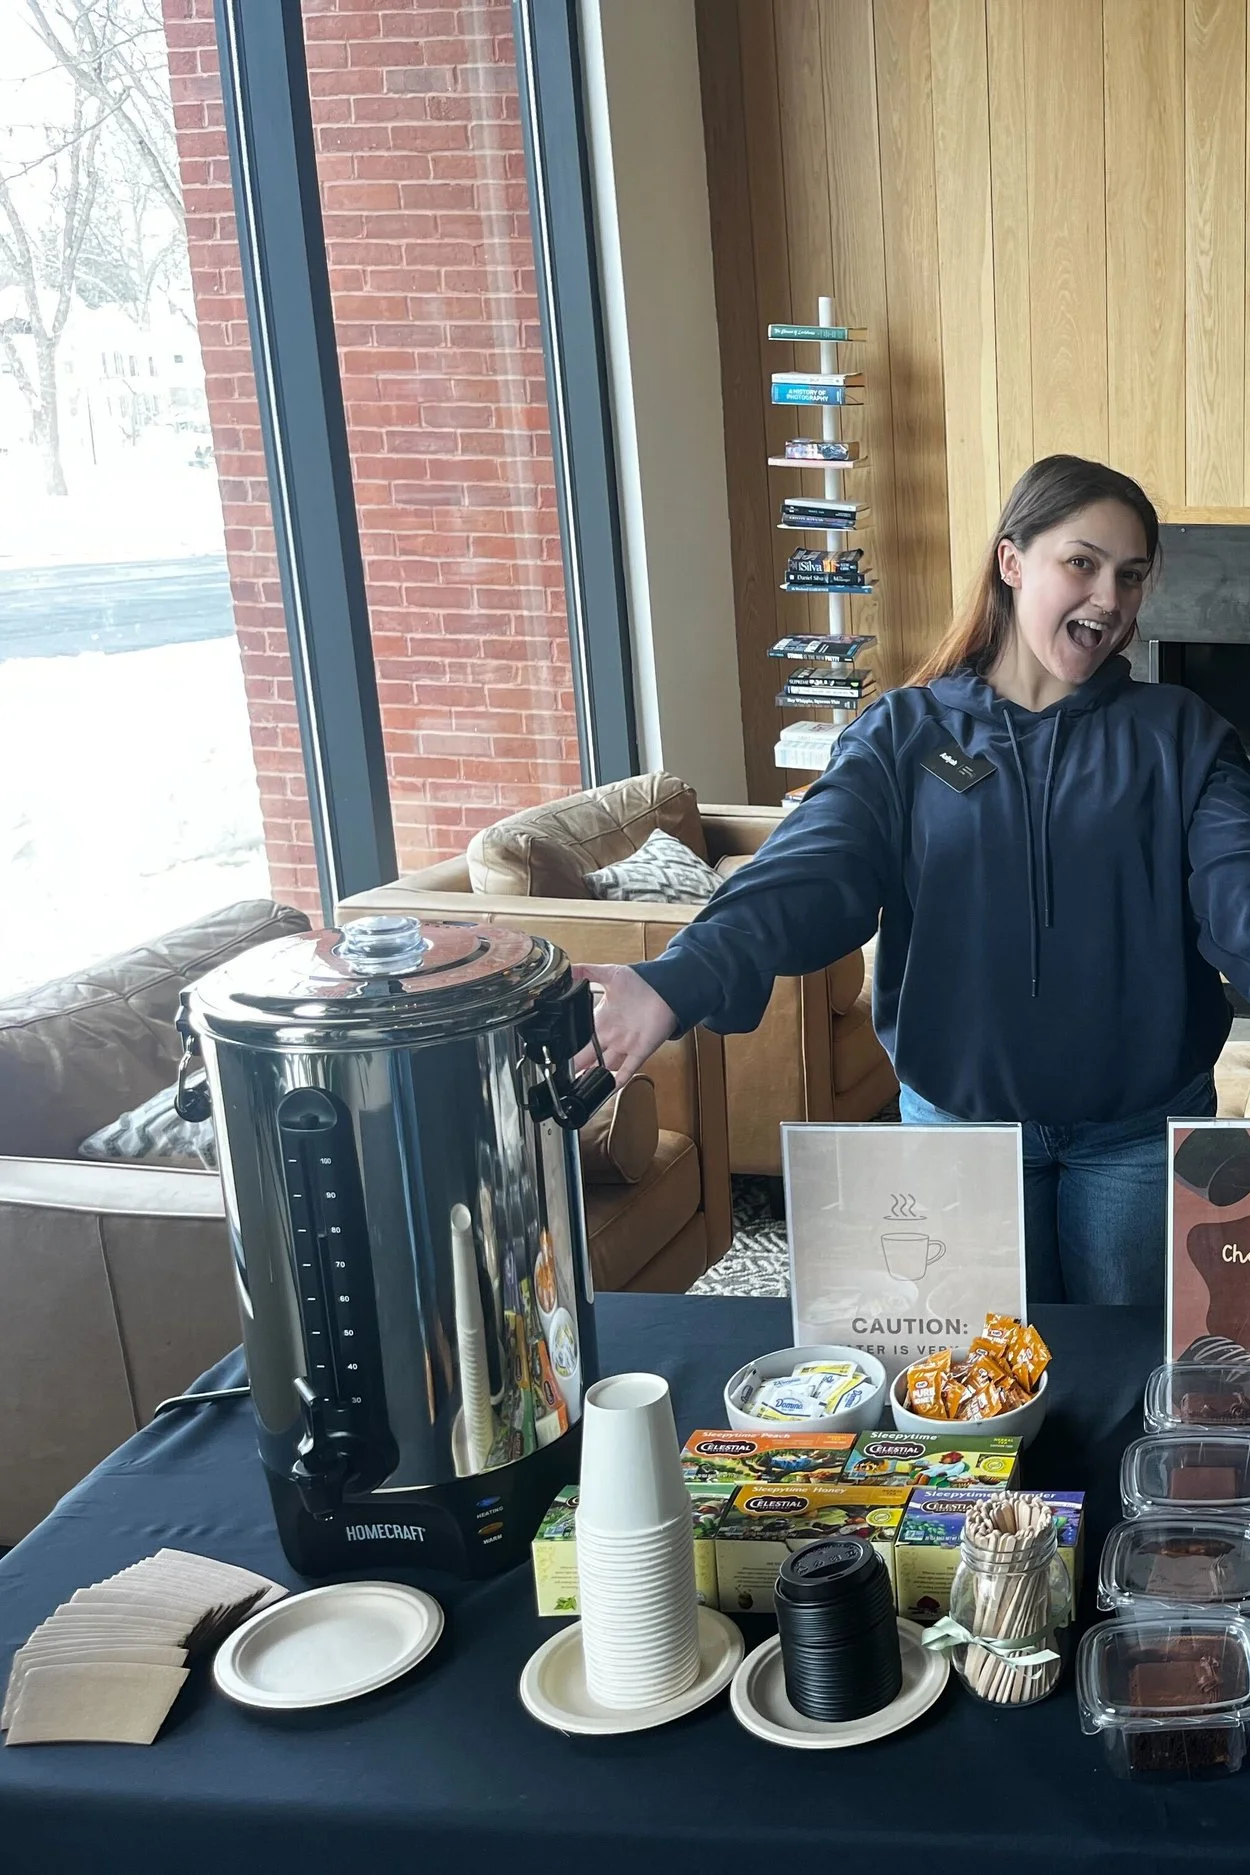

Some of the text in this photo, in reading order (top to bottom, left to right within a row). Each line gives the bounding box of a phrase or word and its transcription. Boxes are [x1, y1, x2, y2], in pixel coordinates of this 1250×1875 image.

[786, 394, 828, 402] PHOTOGRAPHY
[852, 1318, 968, 1334] CAUTION:
[894, 1345, 909, 1355] IS
[776, 1398, 803, 1410] Domino
[870, 1432, 938, 1441] Sleepytime
[700, 1443, 751, 1451] CELESTIAL
[869, 1445, 919, 1454] CELESTIAL
[813, 1487, 847, 1495] Honey
[749, 1499, 802, 1508] CELESTIAL
[476, 1506, 504, 1519] HEATING
[345, 1524, 424, 1544] HOMECRAFT
[482, 1533, 503, 1545] WARM
